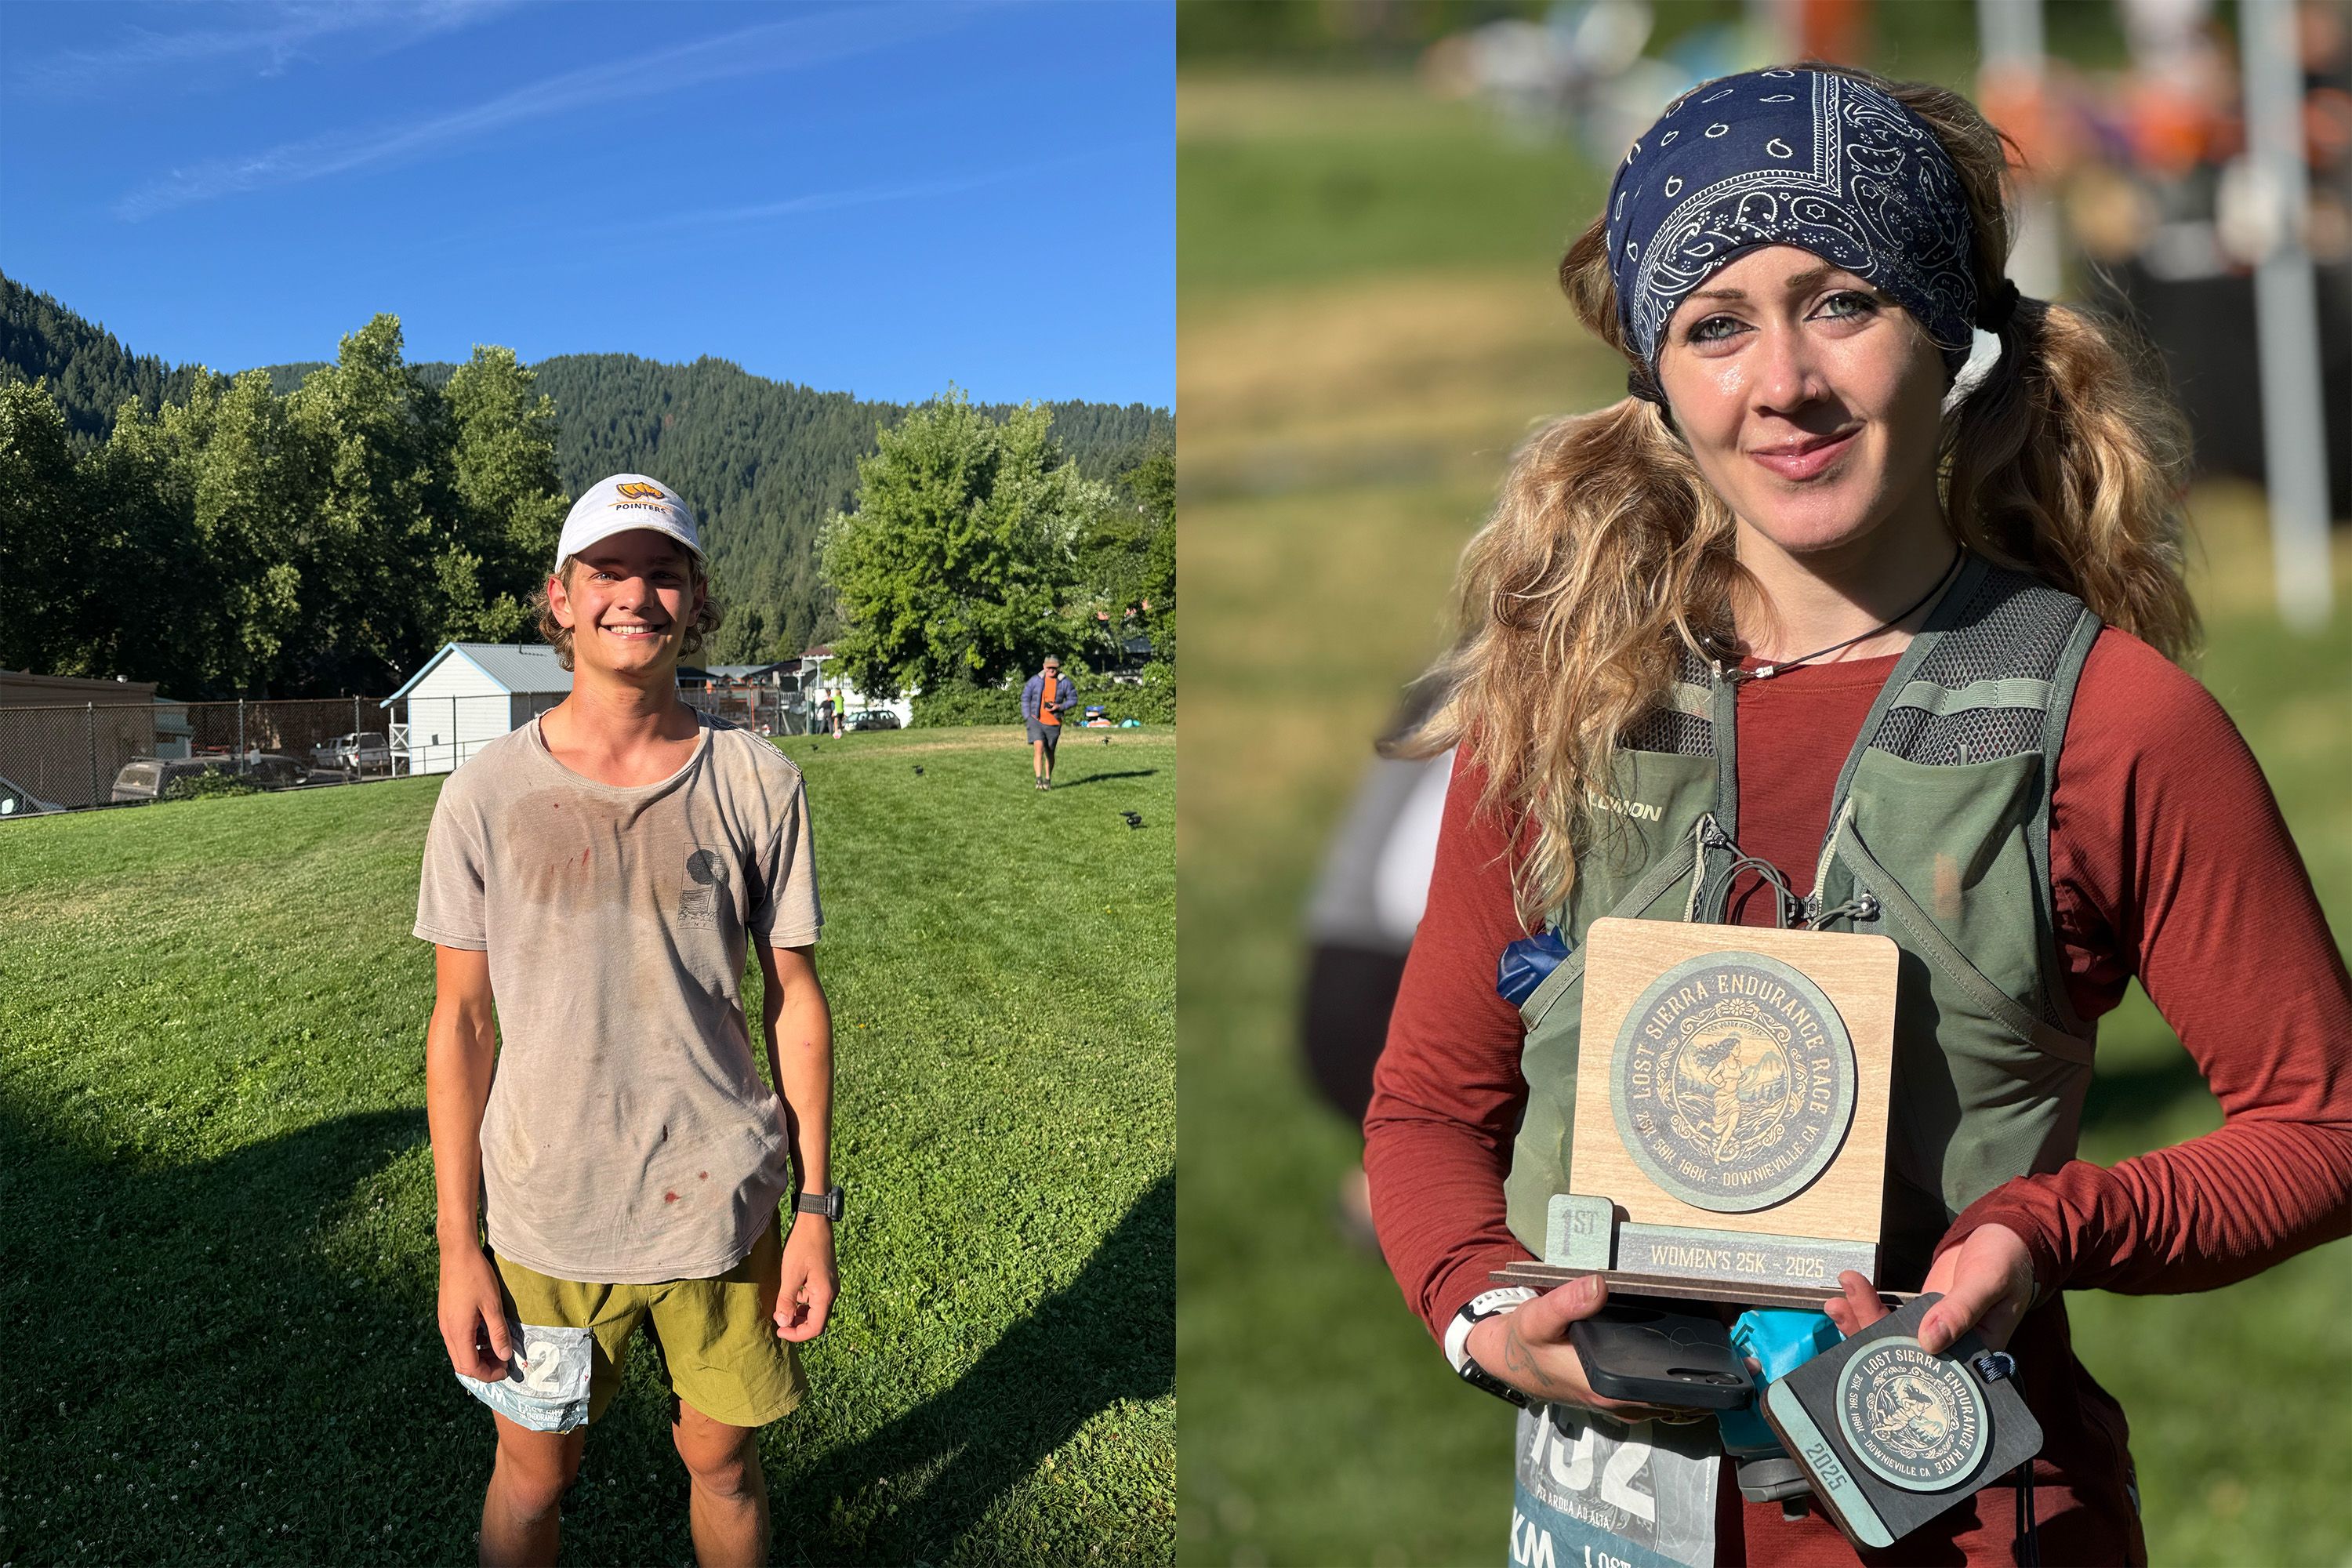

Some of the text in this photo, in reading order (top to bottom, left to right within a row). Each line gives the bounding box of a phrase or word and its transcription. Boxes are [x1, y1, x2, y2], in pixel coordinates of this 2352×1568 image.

[616, 503, 666, 514] POINTERS
[1588, 793, 1663, 822] LOMON
[1632, 975, 1831, 1115] LOST SIERRA ENDURANCE RACE
[1802, 1125, 1820, 1142] CA
[1561, 1209, 1599, 1255] 1ST
[1651, 1245, 1731, 1270] WOMEN'S
[1736, 1252, 1766, 1273] 25K
[1785, 1255, 1825, 1278] 2025
[1863, 1351, 1892, 1376] LOST
[1895, 1349, 1941, 1374] SIERRA
[1944, 1371, 1976, 1450] ENDURANCE
[1806, 1443, 1847, 1490] 2025
[1864, 1439, 1918, 1476] DOWNIEVILLE
[1919, 1468, 1931, 1477] CA
[1934, 1449, 1965, 1475] RACE
[1548, 1493, 1574, 1515] ARDUA
[1577, 1504, 1588, 1519] AD
[1590, 1512, 1610, 1529] ALTA
